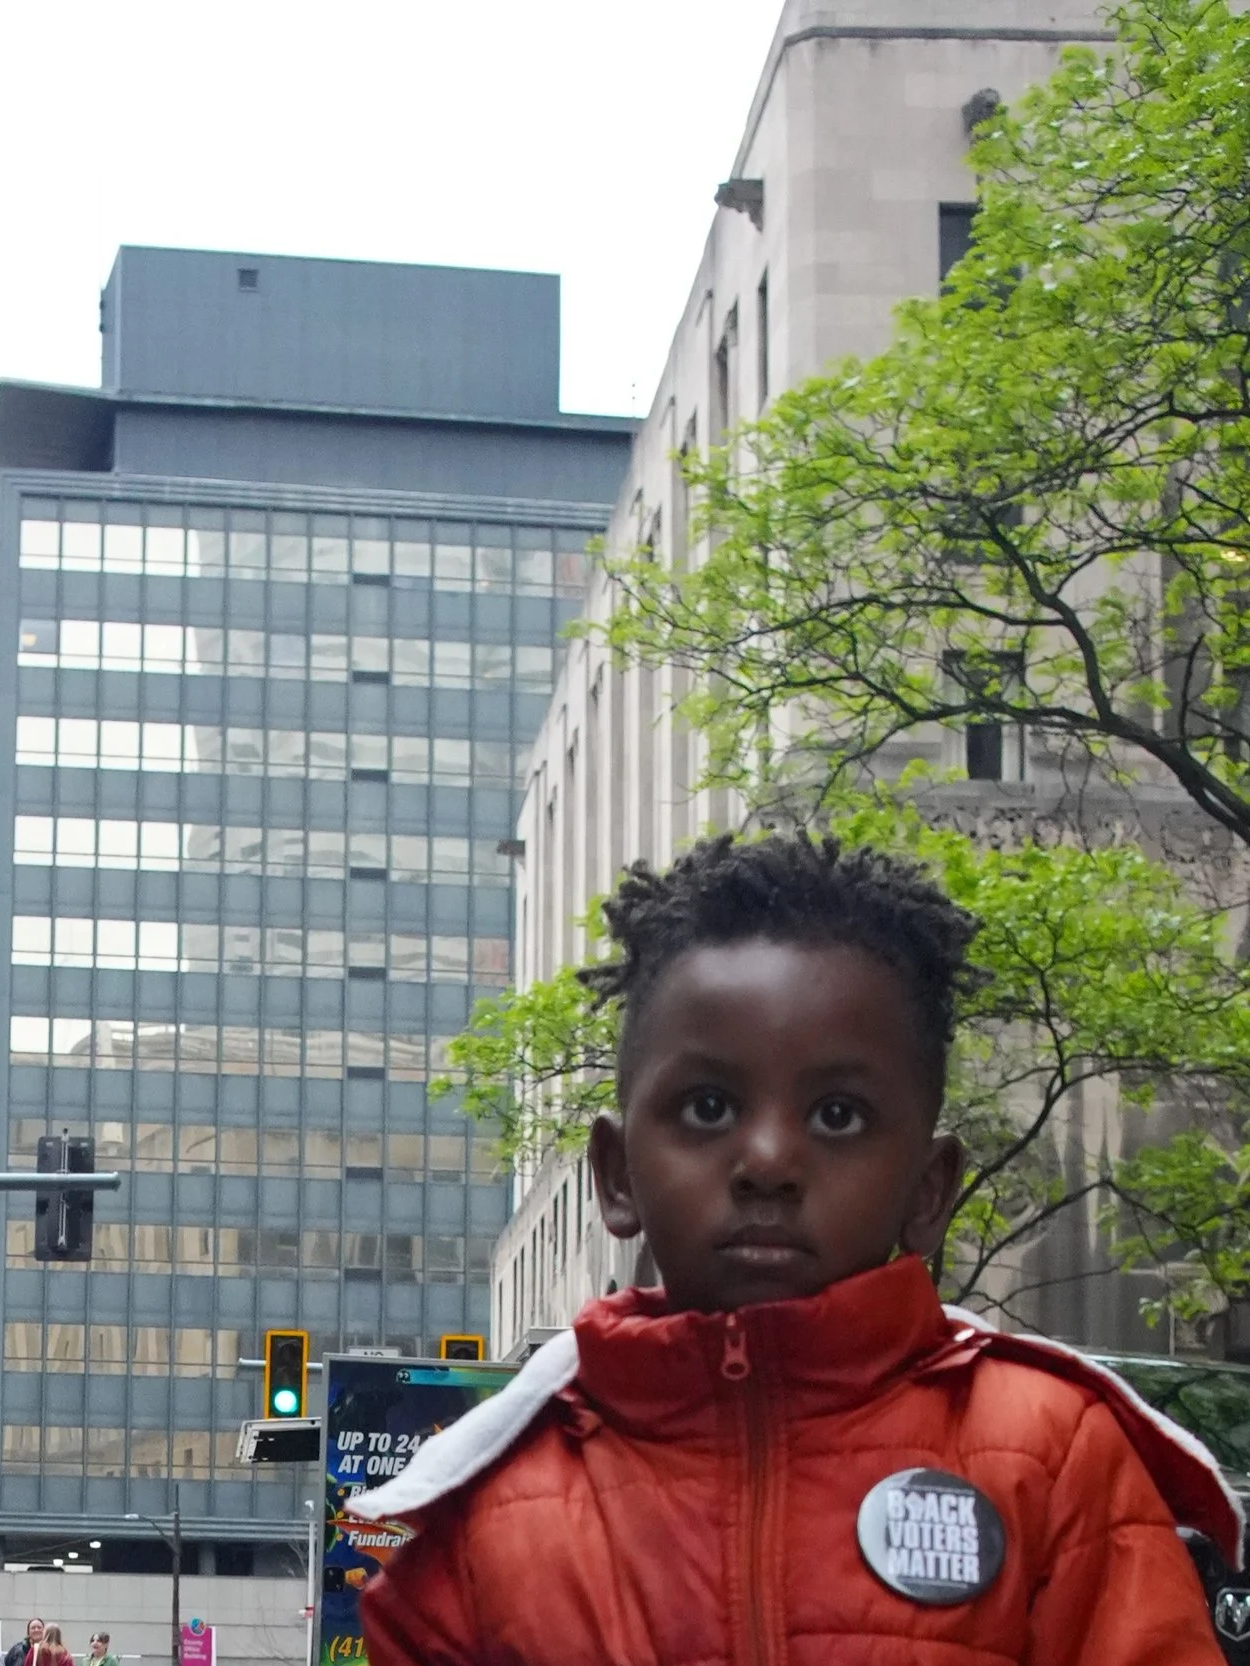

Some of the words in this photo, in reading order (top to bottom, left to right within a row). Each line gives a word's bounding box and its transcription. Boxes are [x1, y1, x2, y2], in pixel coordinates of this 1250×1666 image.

[337, 1431, 364, 1451] UP
[368, 1432, 392, 1453] TO
[395, 1434, 421, 1454] 24
[337, 1454, 364, 1474] AT
[366, 1456, 406, 1476] ONE
[889, 1520, 979, 1555] VOTERS
[887, 1548, 980, 1584] MATTER
[330, 1636, 364, 1662] (41
